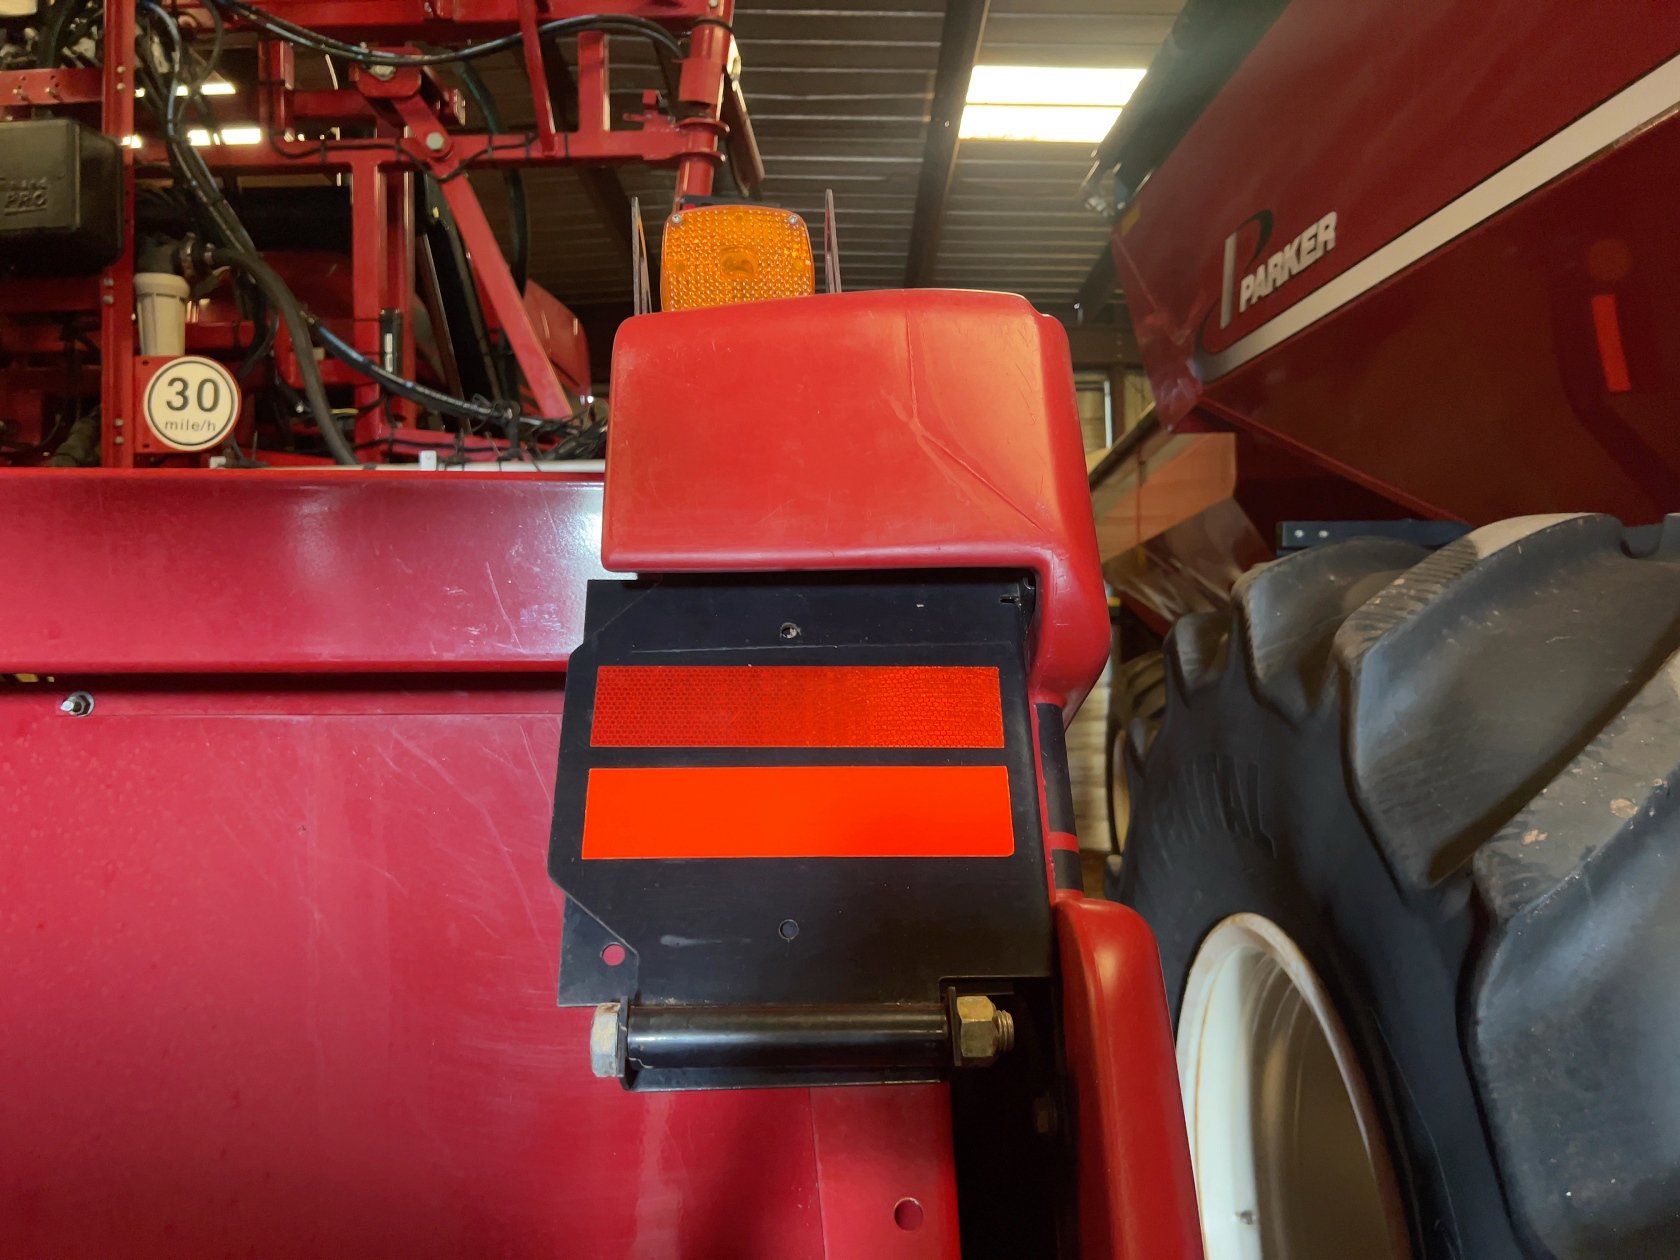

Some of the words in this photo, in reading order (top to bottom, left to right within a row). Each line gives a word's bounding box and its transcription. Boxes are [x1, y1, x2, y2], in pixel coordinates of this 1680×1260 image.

[1239, 211, 1338, 313] PARKER
[166, 377, 221, 412] 30
[164, 418, 217, 432] mile/h
